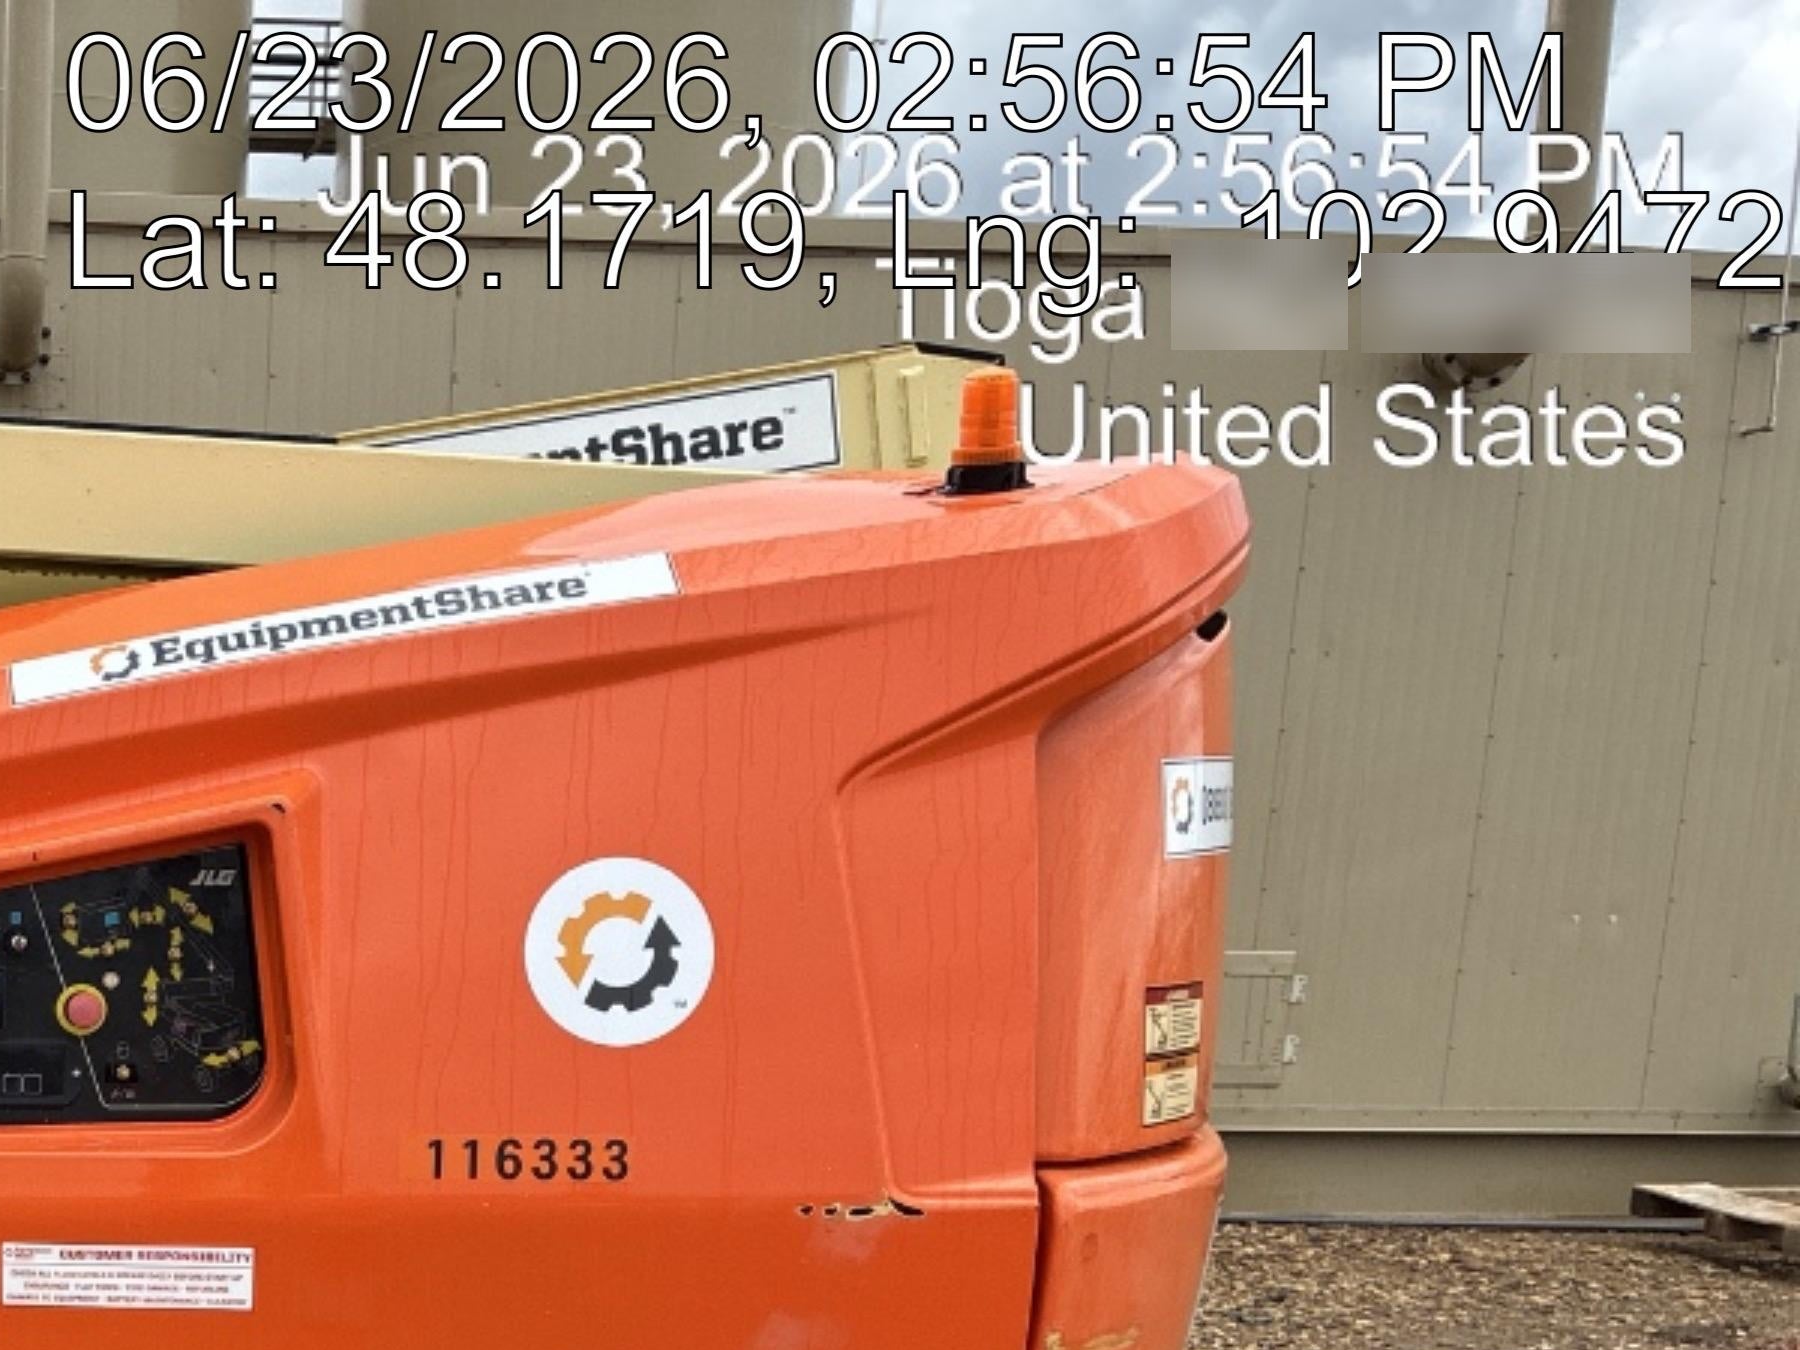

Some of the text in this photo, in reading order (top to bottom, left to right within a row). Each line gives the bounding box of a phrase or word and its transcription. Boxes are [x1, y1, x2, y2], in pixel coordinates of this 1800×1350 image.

[151, 572, 587, 667] EquipmentShare
[189, 870, 237, 886] JLG
[428, 1139, 629, 1180] 116333
[59, 1249, 132, 1261] CUSTOMER
[137, 1250, 251, 1263] RESPONSIBILITY
